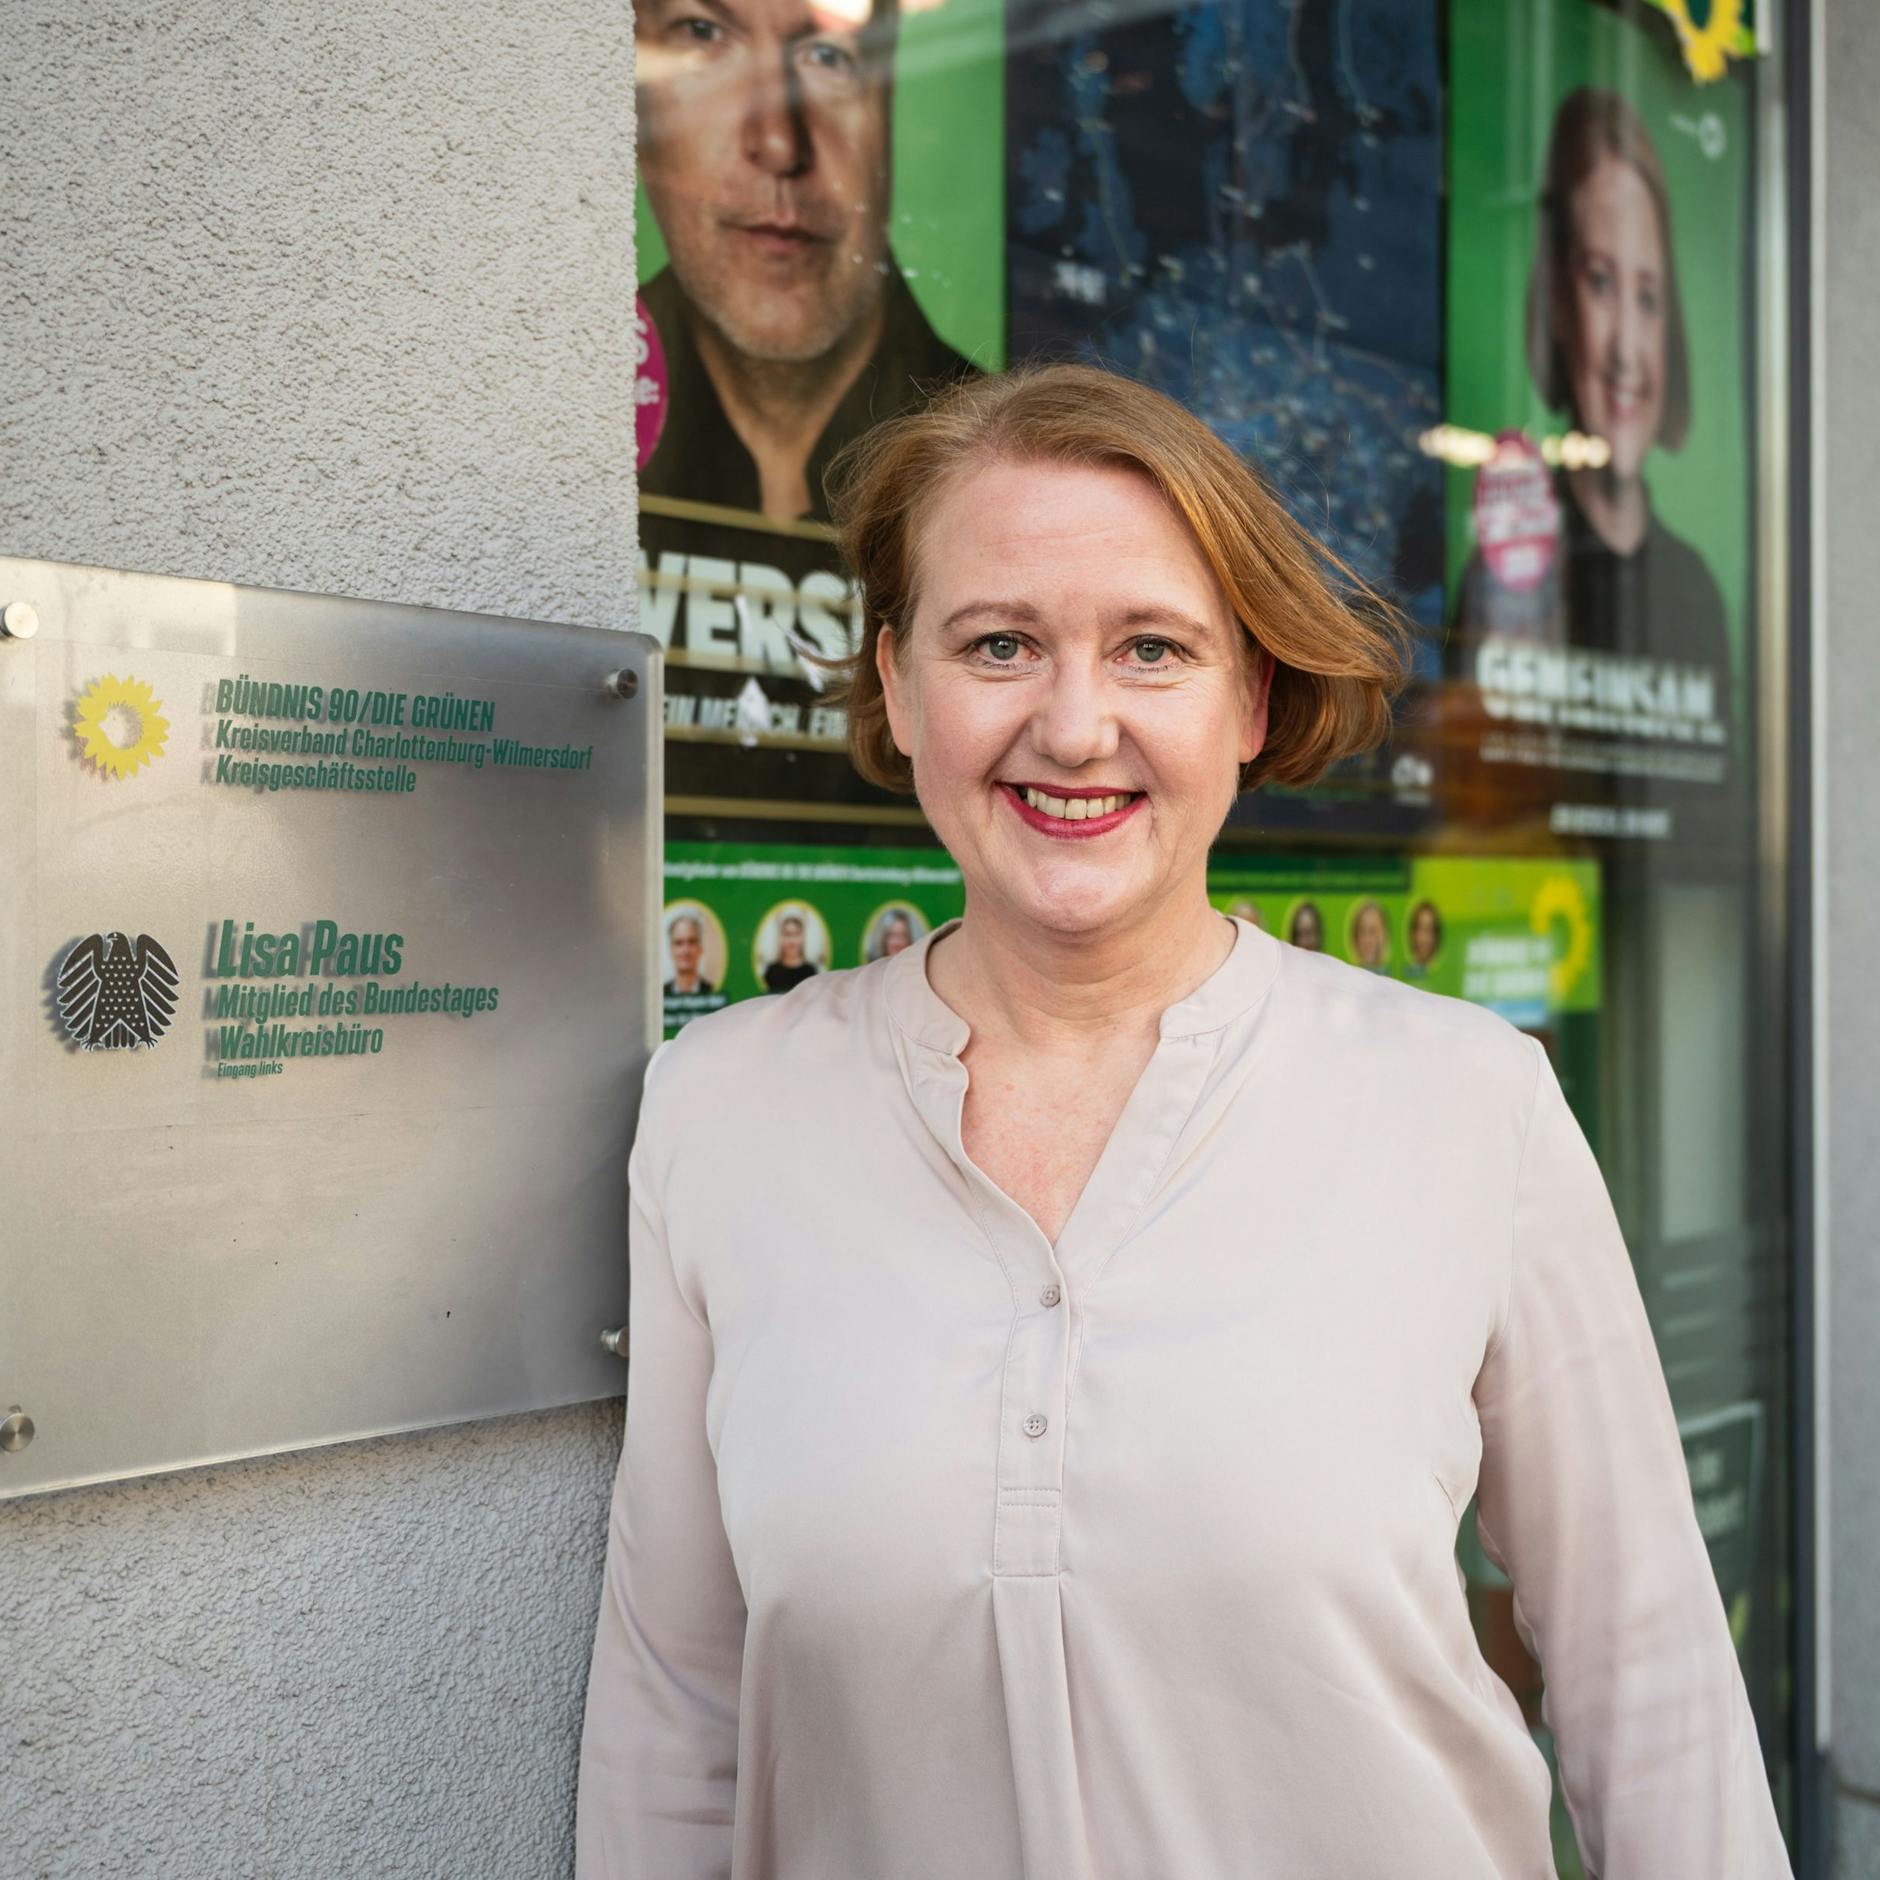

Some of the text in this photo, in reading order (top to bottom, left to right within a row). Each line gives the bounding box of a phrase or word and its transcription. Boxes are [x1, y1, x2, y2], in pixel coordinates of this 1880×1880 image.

[215, 674, 496, 732] BÜNDNIS 90/DIE GRÜNEN
[215, 719, 594, 770] Kreisverband Charlottenburg-Wilmersdorf
[215, 754, 417, 792] Kreisgeschäftsstelle
[217, 919, 405, 977] Lisa Paus
[217, 981, 499, 1024] Mitglied des Bundestages
[220, 1022, 384, 1059] Wahlkreisbüro
[217, 1060, 284, 1079] Eingang links
